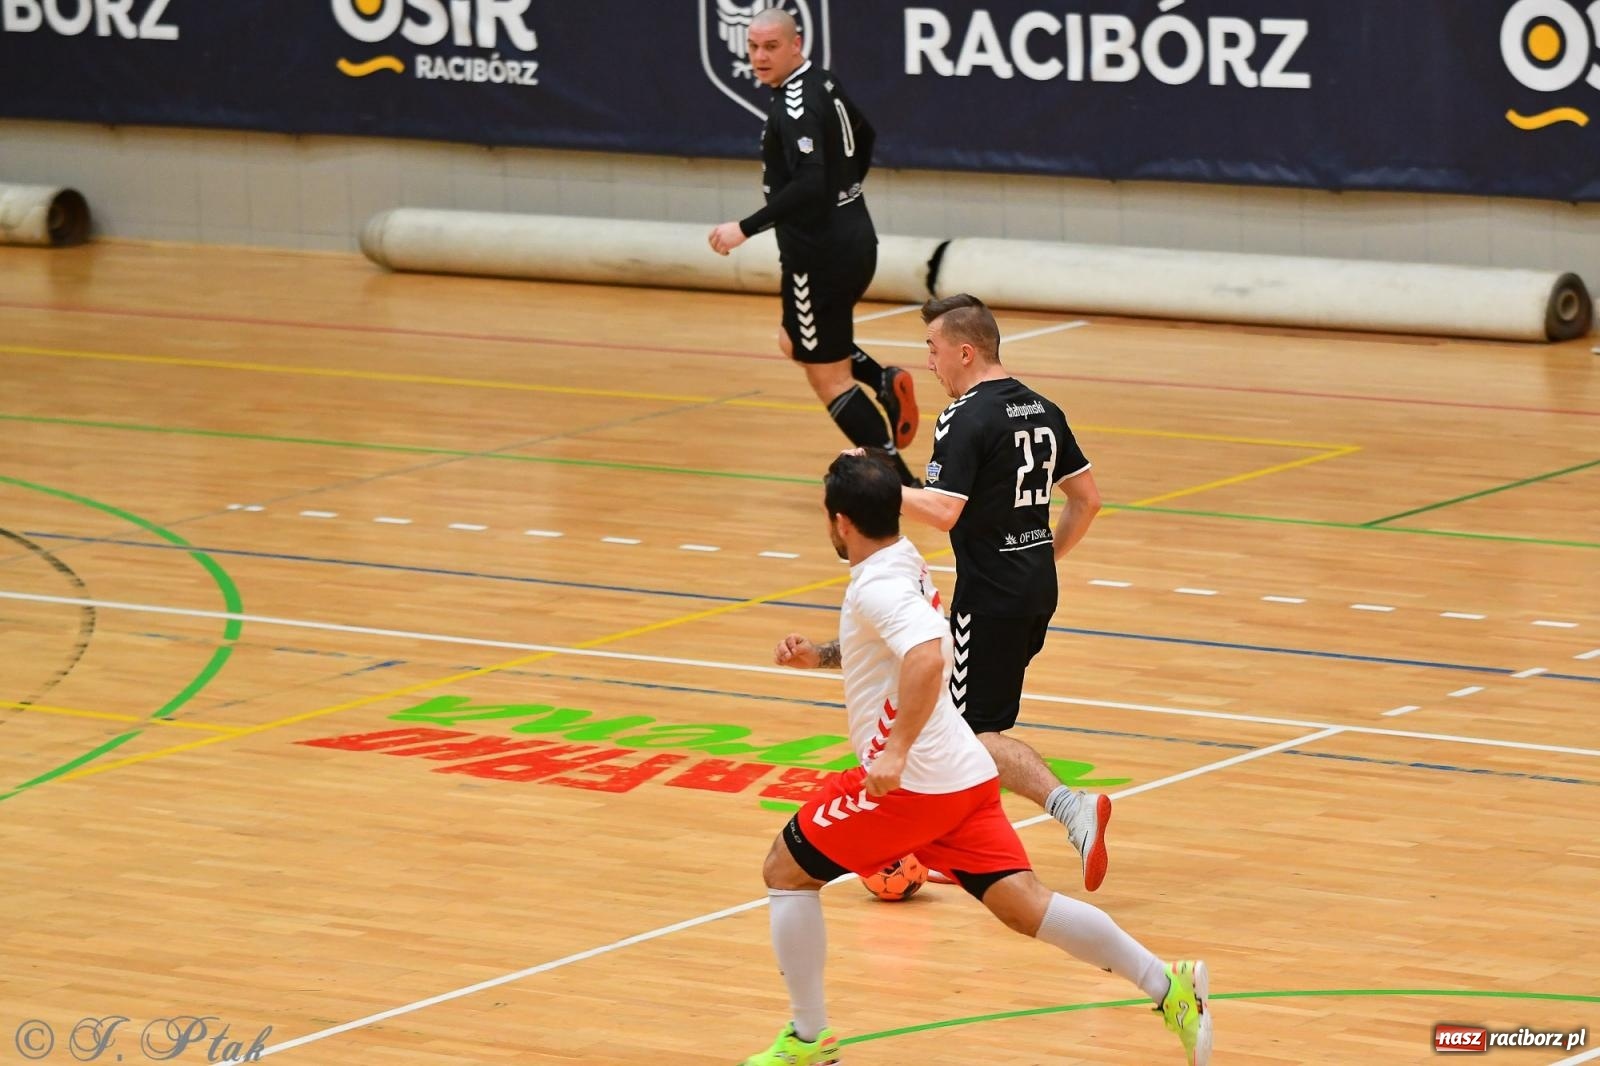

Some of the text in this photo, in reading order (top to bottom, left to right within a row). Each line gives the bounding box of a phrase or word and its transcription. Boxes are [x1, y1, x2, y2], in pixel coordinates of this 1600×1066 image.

[415, 53, 539, 86] RACIBÓRZ
[904, 0, 1311, 89] RACIBÓRZ
[1014, 426, 1058, 508] 23
